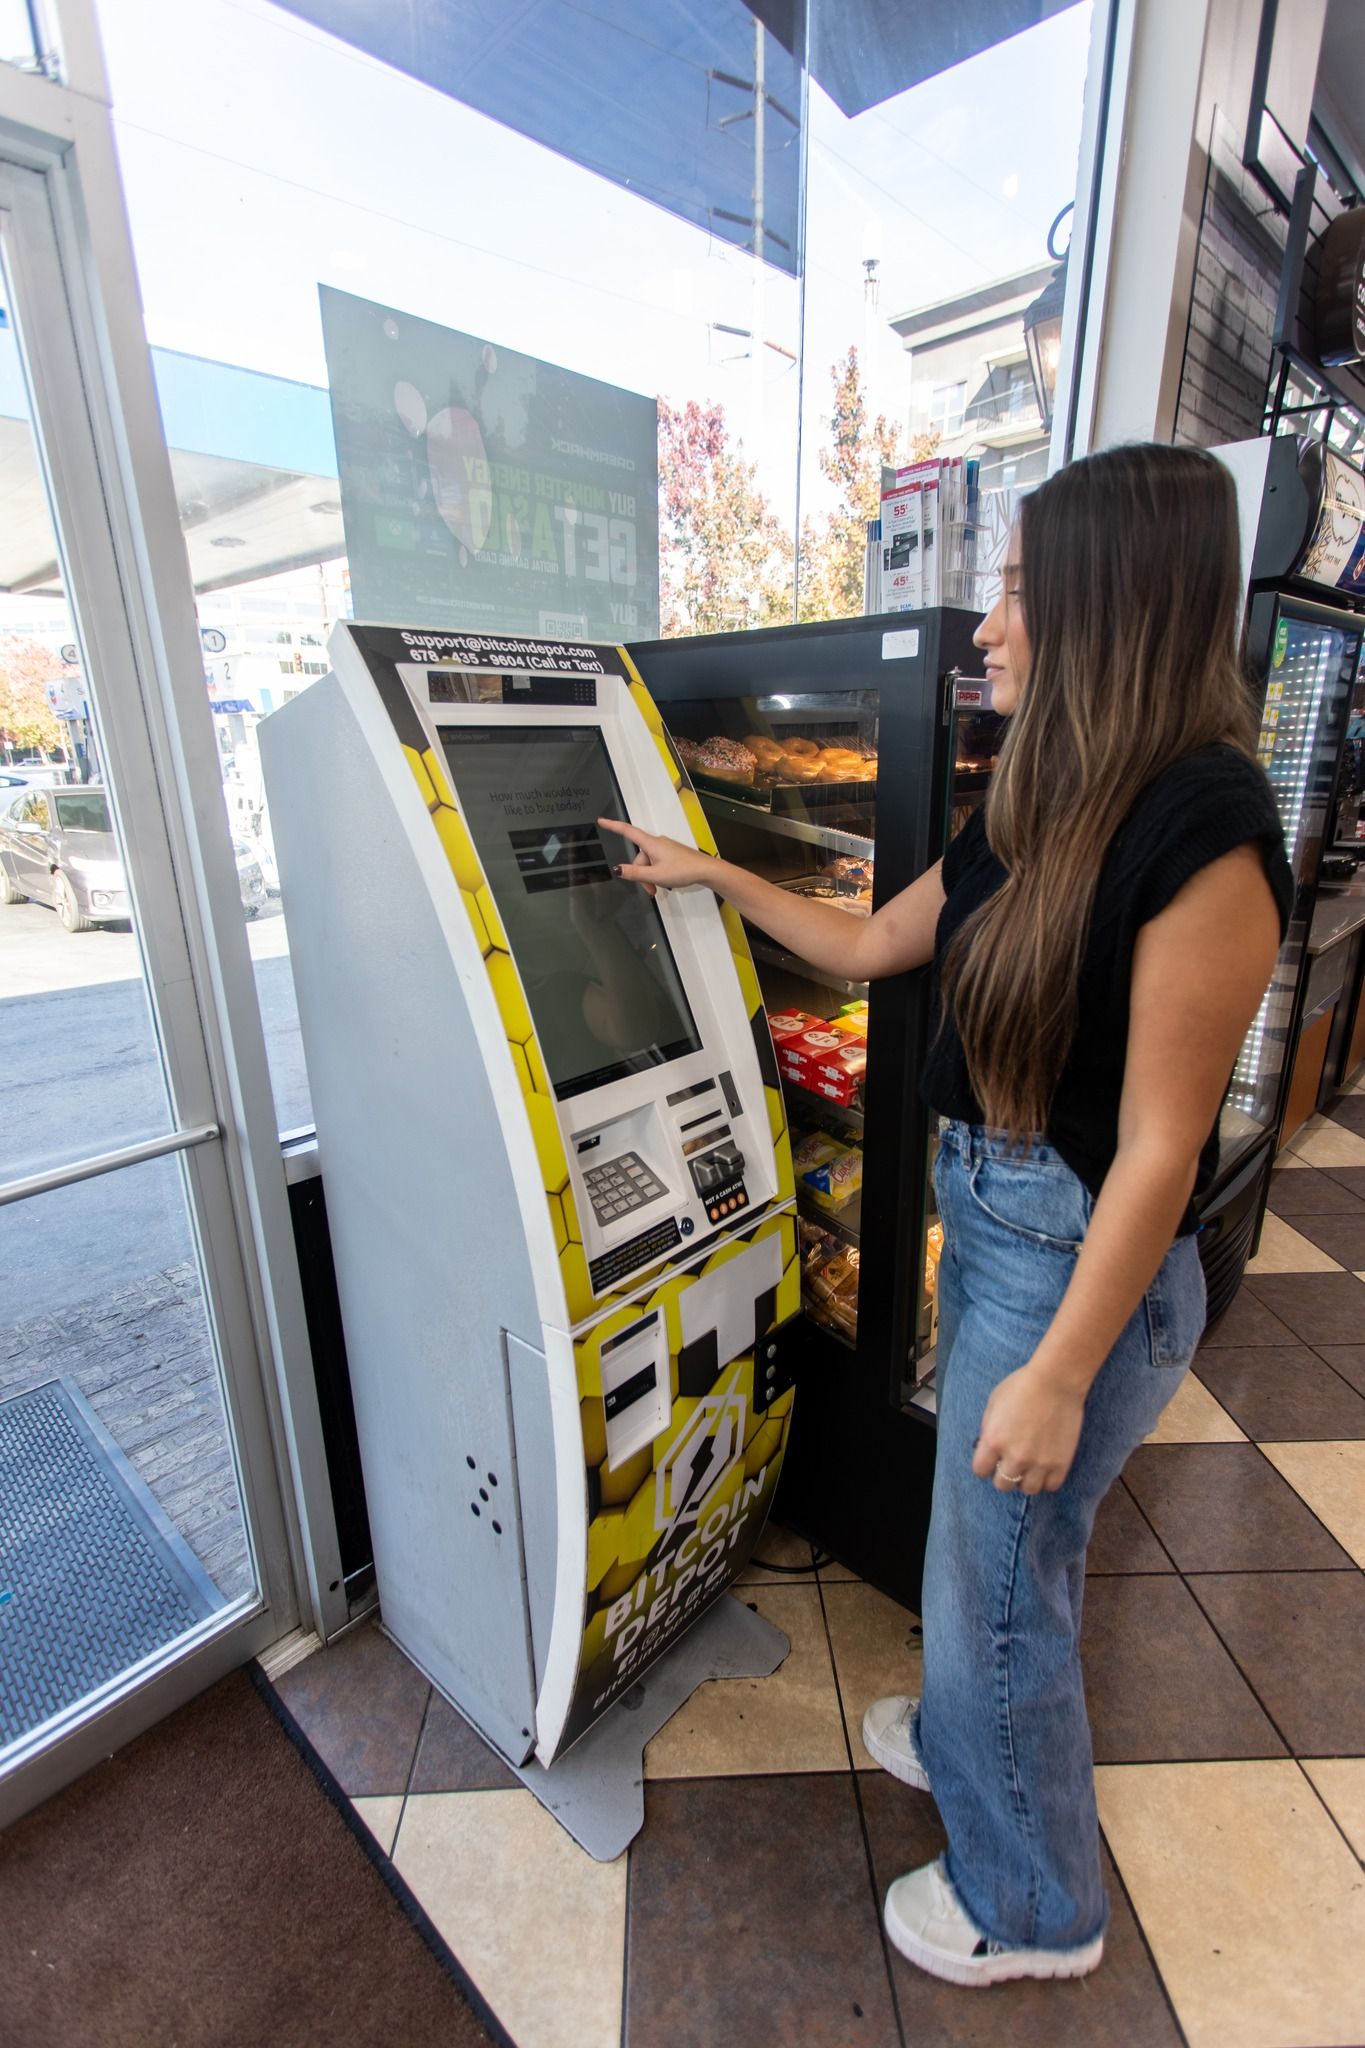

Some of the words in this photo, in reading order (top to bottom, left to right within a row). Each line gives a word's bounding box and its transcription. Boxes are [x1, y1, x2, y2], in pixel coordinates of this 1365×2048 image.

[400, 631, 597, 660] Support@bitcoindepot.com
[410, 649, 439, 662] 678
[451, 651, 479, 665] 435
[489, 654, 526, 668] 9604
[526, 655, 557, 670] (Call
[559, 659, 572, 670] or
[571, 659, 604, 674] Text)
[489, 791, 513, 802] How
[515, 788, 542, 800] much
[544, 787, 572, 799] would
[573, 787, 590, 798] you
[504, 804, 522, 816] like
[524, 804, 535, 815] to
[536, 803, 554, 815] buy
[556, 800, 584, 812] today?
[604, 1466, 767, 1639] BITCOIN
[613, 1513, 748, 1661] DEPOT
